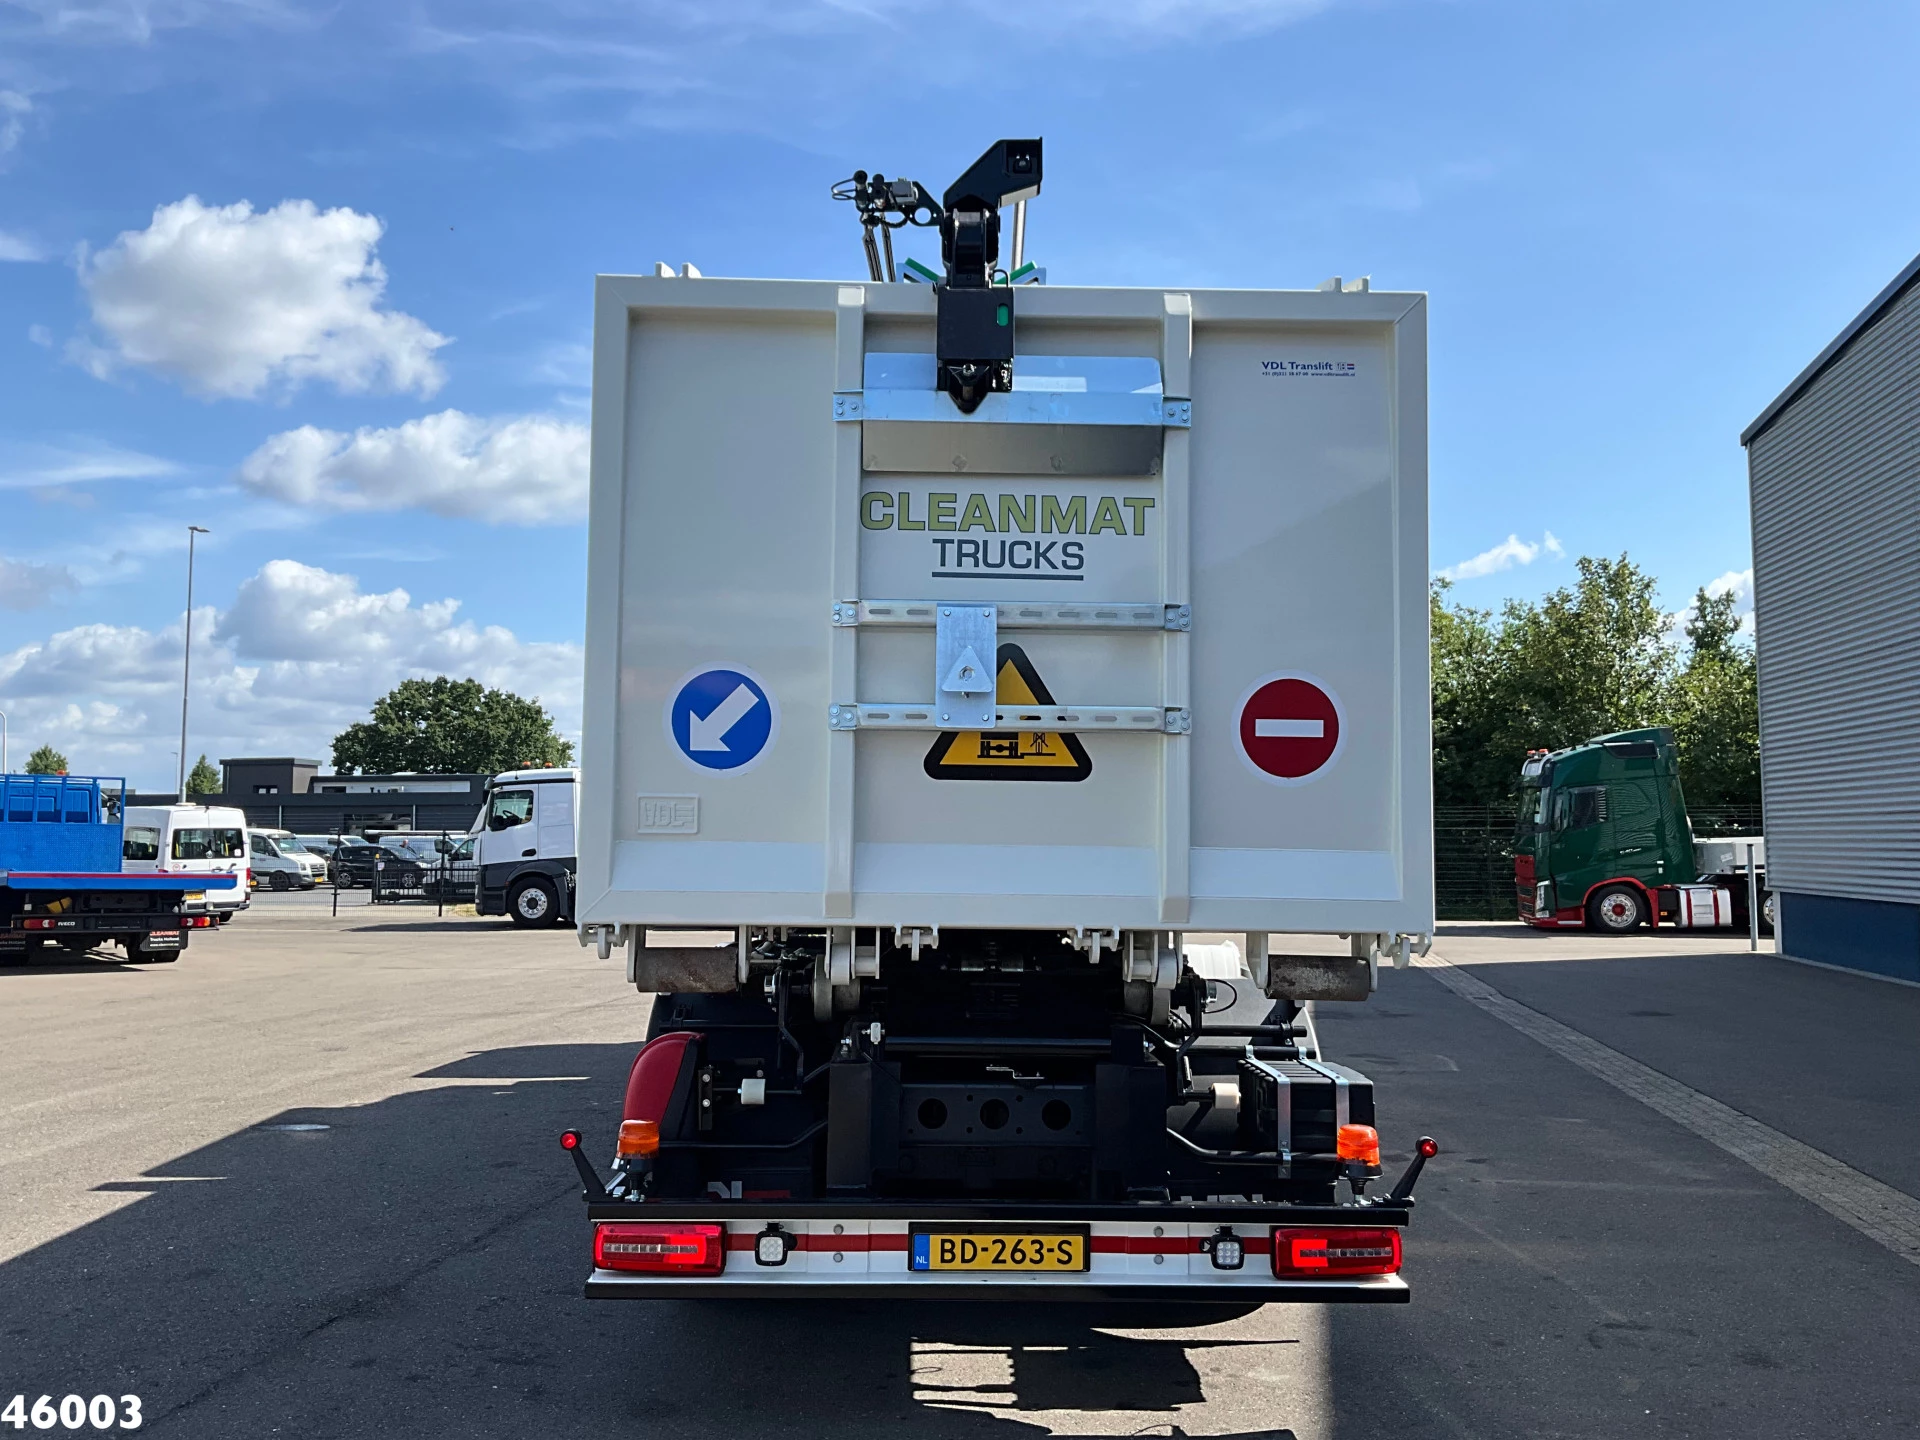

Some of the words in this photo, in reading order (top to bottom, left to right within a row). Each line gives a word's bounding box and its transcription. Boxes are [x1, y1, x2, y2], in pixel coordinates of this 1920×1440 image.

[1261, 361, 1287, 370] VDL
[1288, 361, 1333, 371] Translift
[860, 491, 1155, 535] CLEANMAT
[932, 538, 1084, 570] TRUCKS
[915, 1255, 928, 1264] NL
[940, 1238, 1073, 1265] BD-263-S
